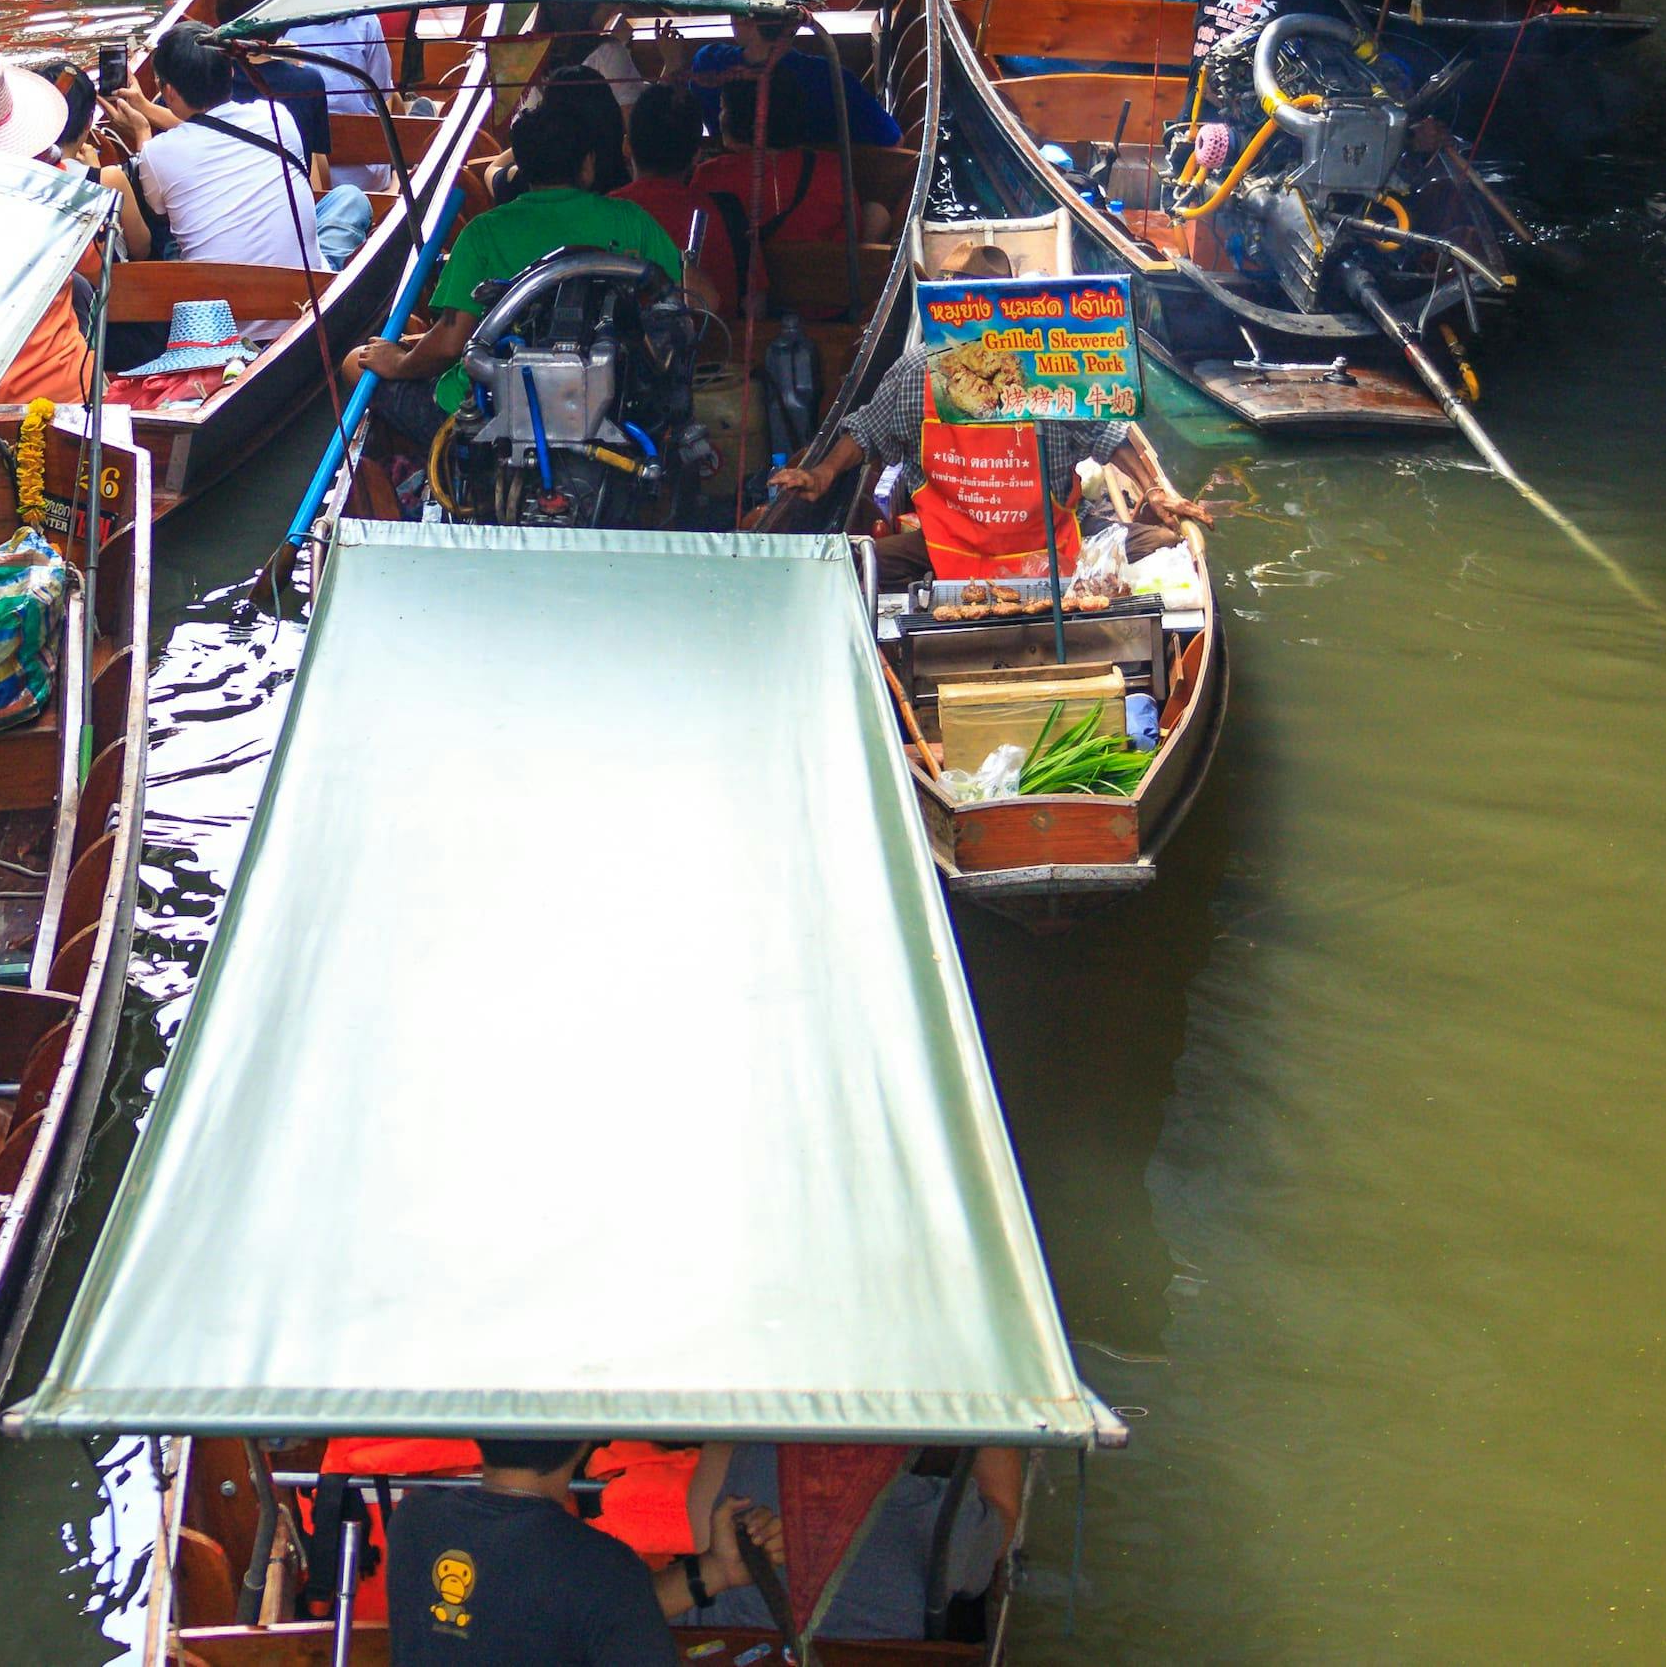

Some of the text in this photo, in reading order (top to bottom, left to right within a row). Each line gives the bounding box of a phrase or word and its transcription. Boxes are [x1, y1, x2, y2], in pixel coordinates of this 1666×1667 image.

[930, 288, 1125, 326] หมูย่าง นมสด เจ้าเก่า
[984, 329, 1126, 350] Grilled Skewered
[1037, 355, 1125, 374] Milk Pork
[1002, 384, 1135, 415] 烤猪肉 牛奶
[971, 449, 1021, 469] ตลาดน้ำ
